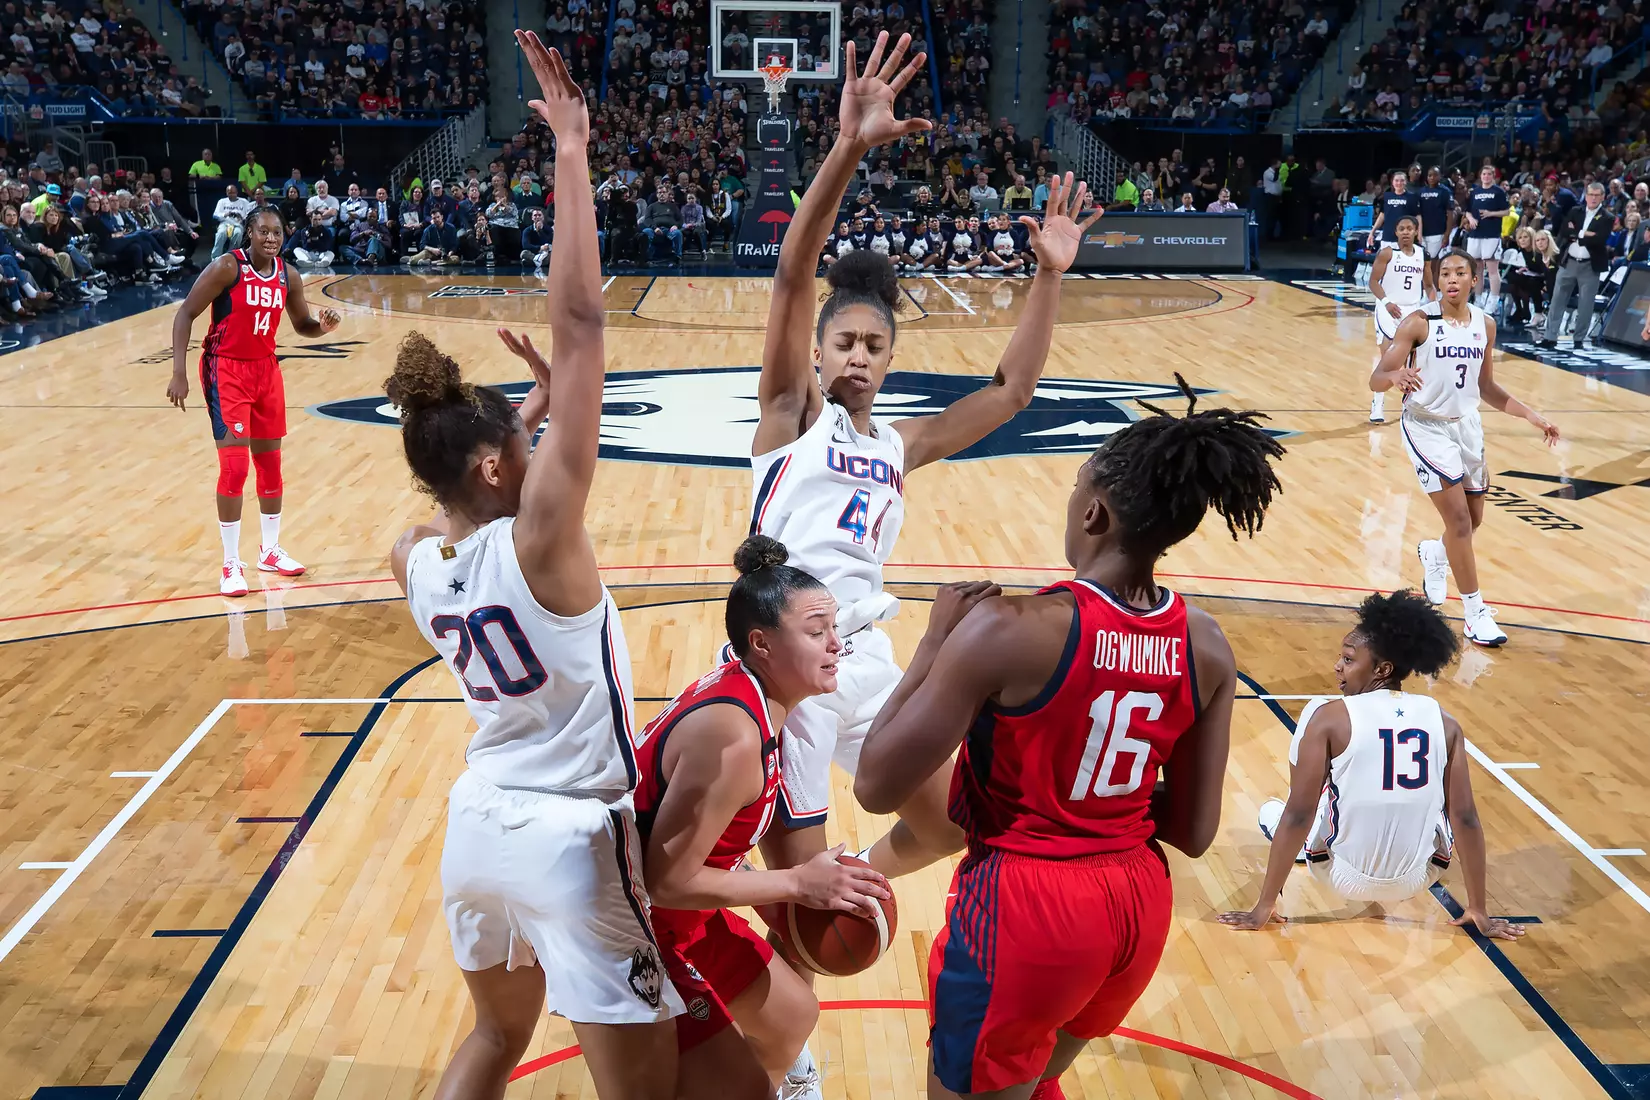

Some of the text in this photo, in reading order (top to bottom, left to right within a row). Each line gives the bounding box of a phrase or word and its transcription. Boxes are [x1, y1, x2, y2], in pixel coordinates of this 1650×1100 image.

[47, 105, 84, 114] BUD LIGHT
[1437, 117, 1473, 126] BUD LIGHT
[1153, 236, 1227, 245] CHEVROLET
[1394, 265, 1423, 274] UCONN
[1403, 275, 1413, 290] 5
[246, 284, 283, 309] USA
[253, 311, 271, 336] 14
[1435, 346, 1484, 359] UCONN
[1455, 364, 1468, 389] 3
[430, 604, 549, 702] 20
[1092, 629, 1182, 676] OGWUMIKE
[1068, 690, 1164, 801] 16
[1378, 728, 1430, 791] 13
